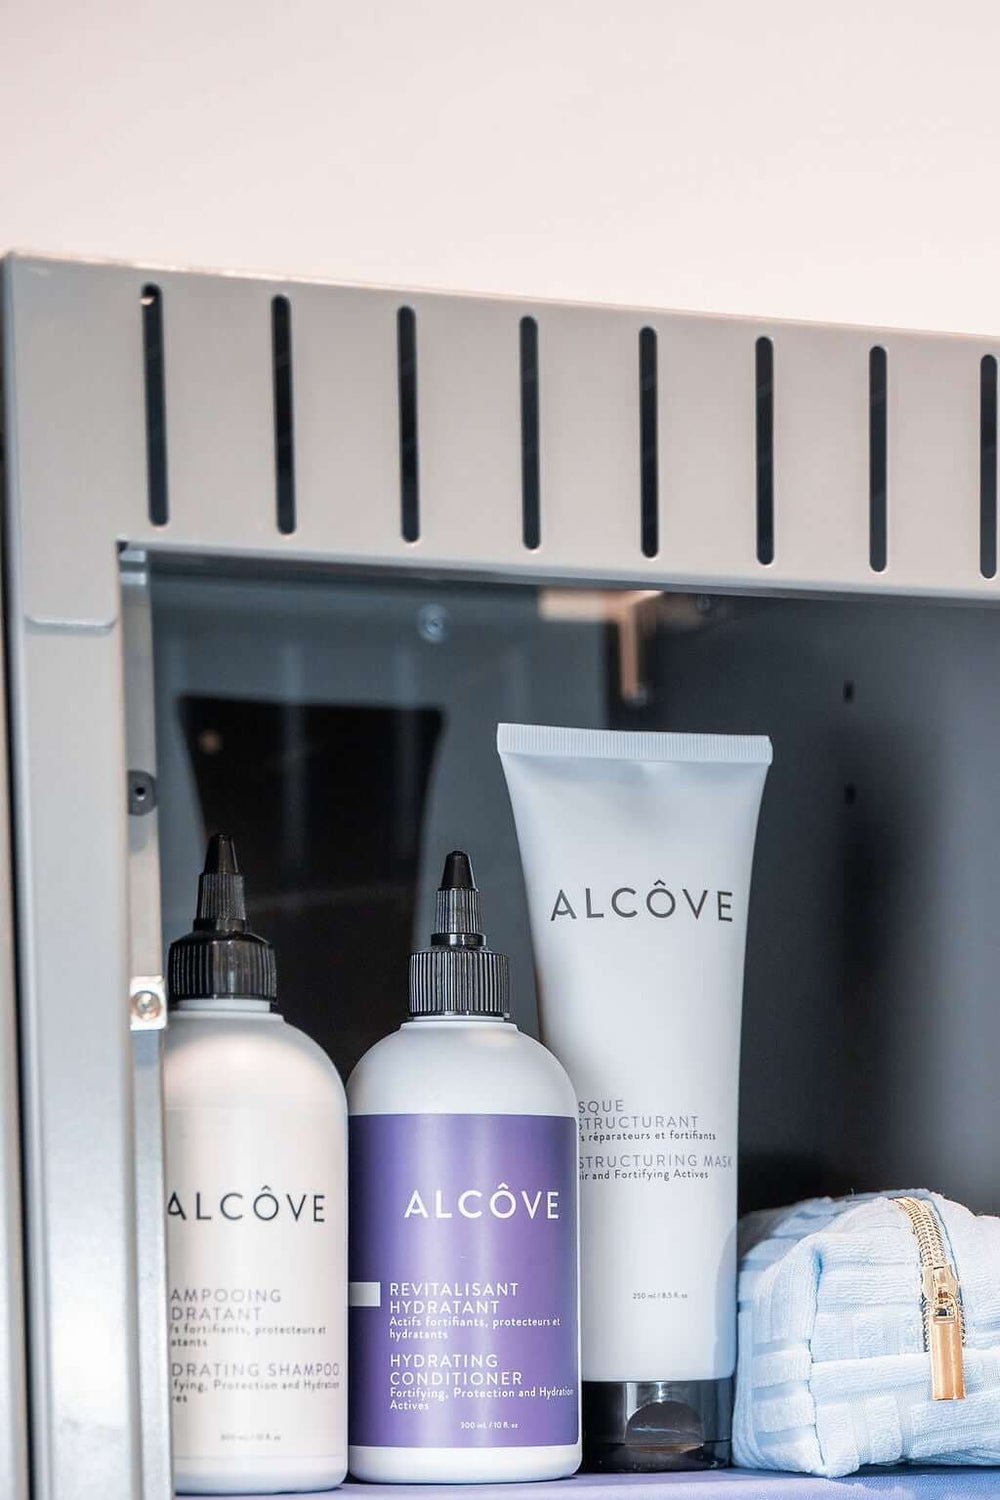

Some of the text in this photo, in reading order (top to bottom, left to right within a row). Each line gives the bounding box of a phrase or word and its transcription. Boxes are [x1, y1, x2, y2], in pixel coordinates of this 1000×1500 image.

[550, 879, 733, 922] ALCÔVE
[578, 1100, 624, 1115] SQUE
[579, 1116, 699, 1130] TRUCTURANT
[588, 1131, 651, 1144] réparateurs
[654, 1131, 665, 1140] et
[670, 1130, 717, 1141] fortifiants
[579, 1154, 733, 1169] STRUCTURING MASK
[592, 1170, 610, 1180] and
[615, 1169, 670, 1182] Fortifying
[673, 1168, 709, 1180] Actives
[168, 1185, 325, 1222] ALCÔVE
[404, 1182, 560, 1219] ALCÔVE
[170, 1288, 282, 1302] AMPOOING
[390, 1282, 519, 1297] REVITALISANT
[171, 1306, 262, 1321] DRATANT
[390, 1300, 500, 1314] HYDRATANT
[389, 1316, 561, 1330] Actifs fortifiants, protecteurs et
[171, 1337, 208, 1347] atants
[389, 1329, 448, 1342] hydratants
[390, 1354, 498, 1368] HYDRATING
[171, 1362, 340, 1377] DRATING SHAMPOO
[174, 1378, 208, 1393] fying,
[390, 1372, 523, 1386] CONDITIONER
[390, 1386, 575, 1402] Fortifying, Protection and Hydration
[389, 1400, 429, 1411] Actives
